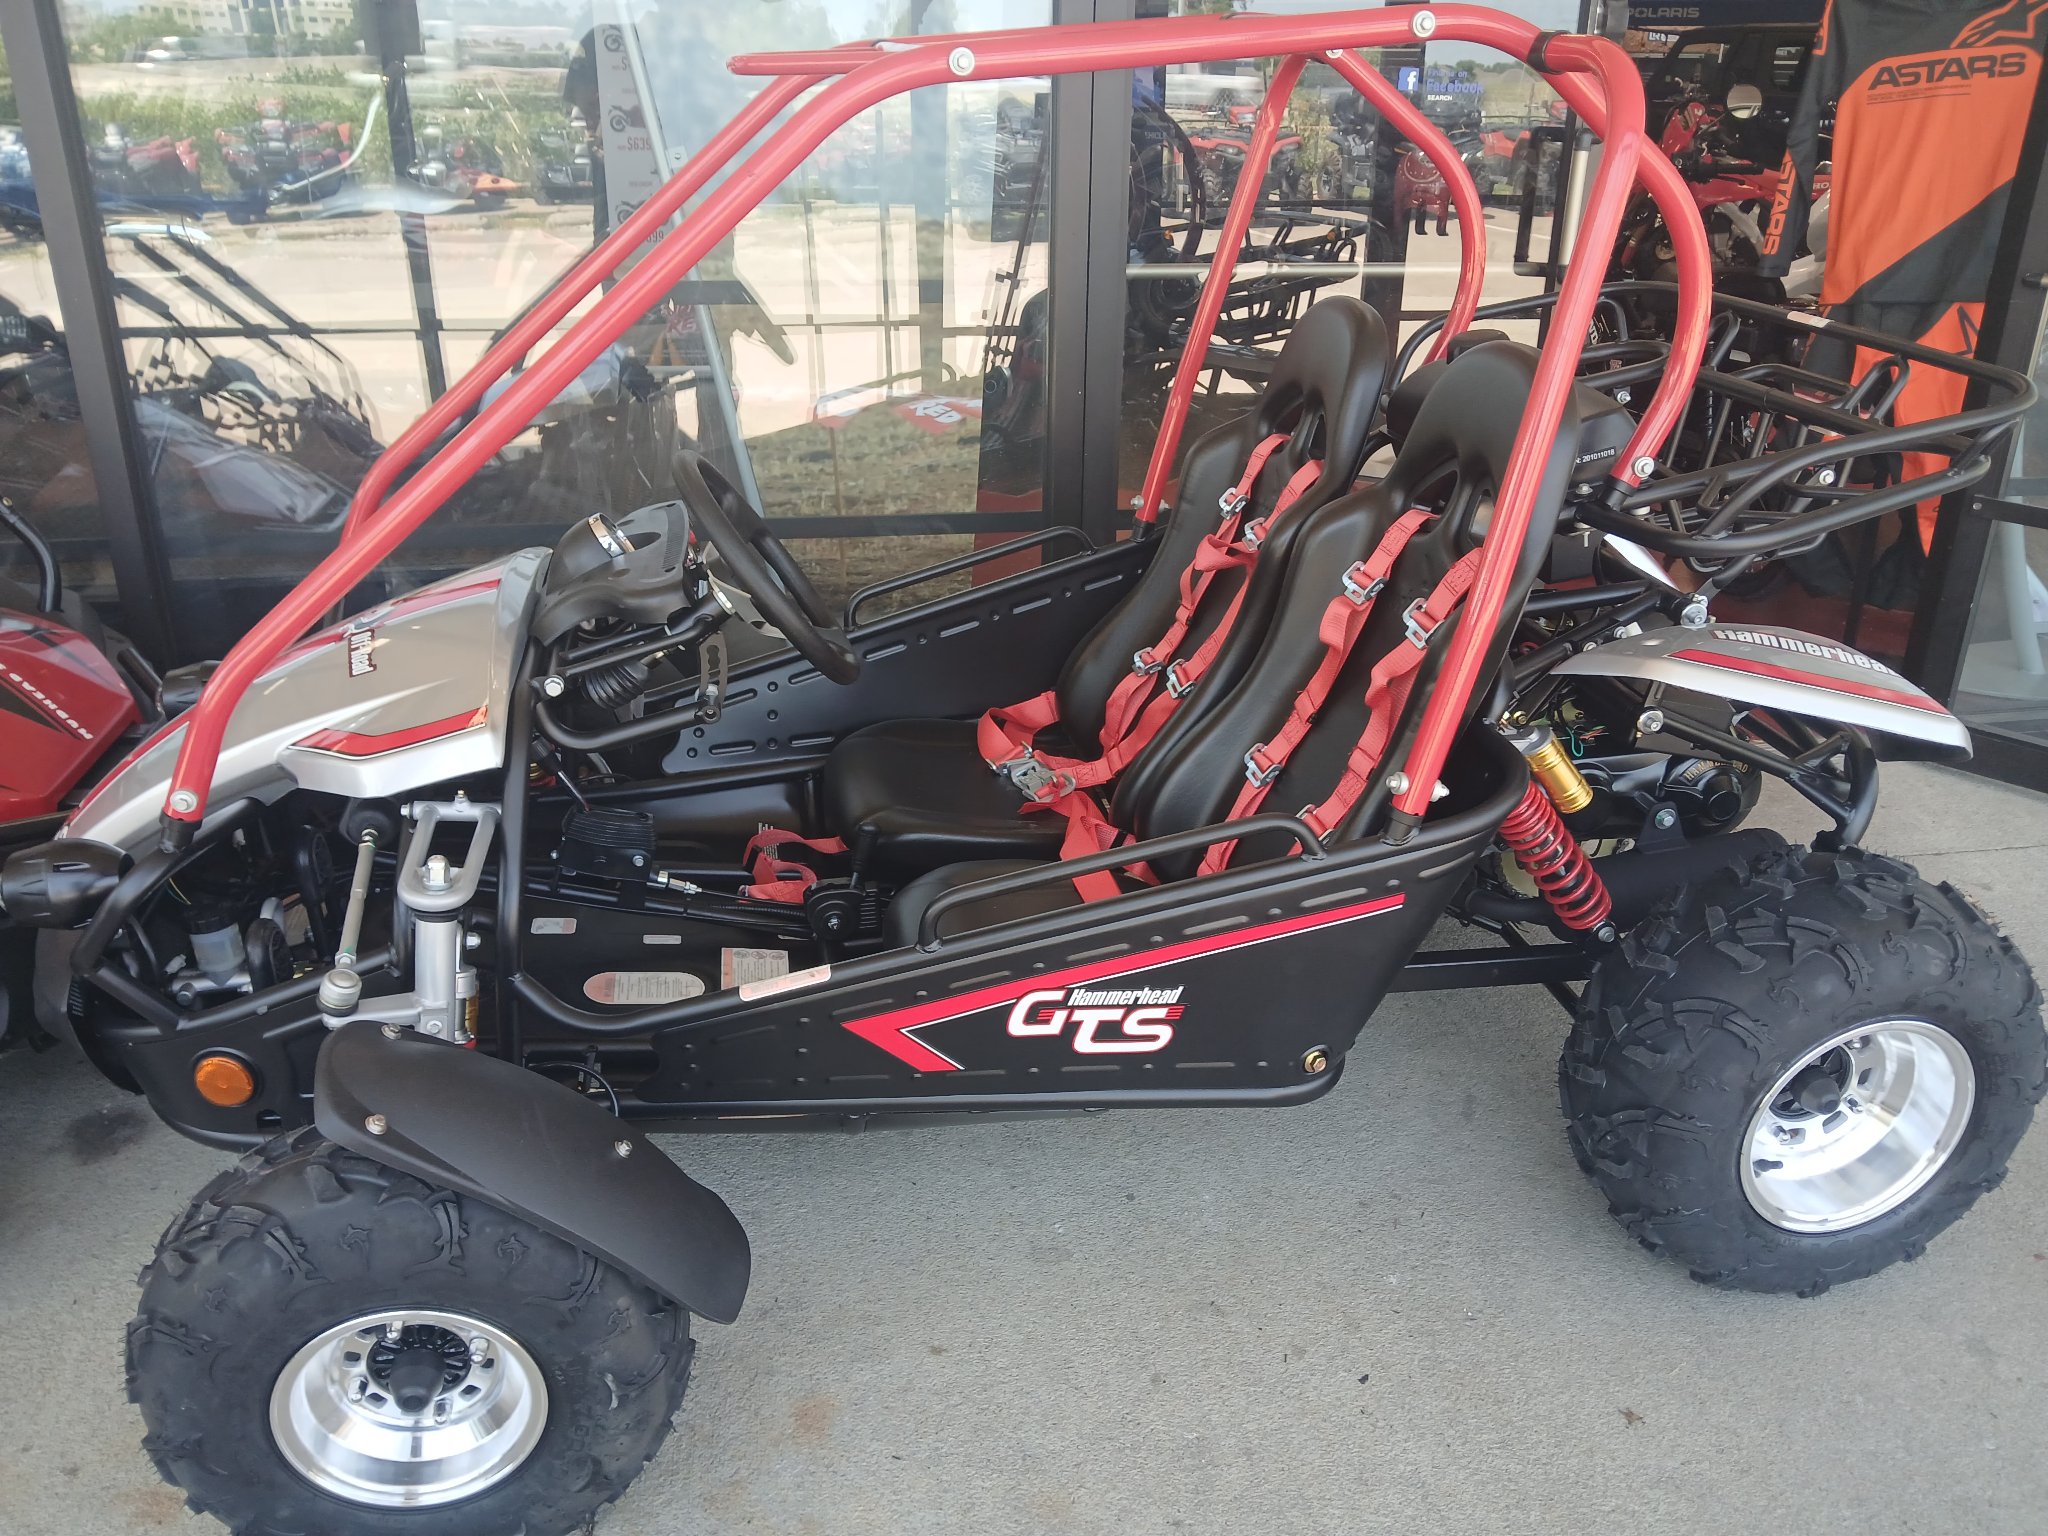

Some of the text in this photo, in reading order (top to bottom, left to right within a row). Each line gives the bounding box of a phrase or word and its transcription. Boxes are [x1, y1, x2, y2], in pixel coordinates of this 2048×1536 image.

[1867, 52, 2027, 91] ASTARS
[1068, 986, 1184, 1006] Hammerhead
[1006, 988, 1185, 1055] GTS
